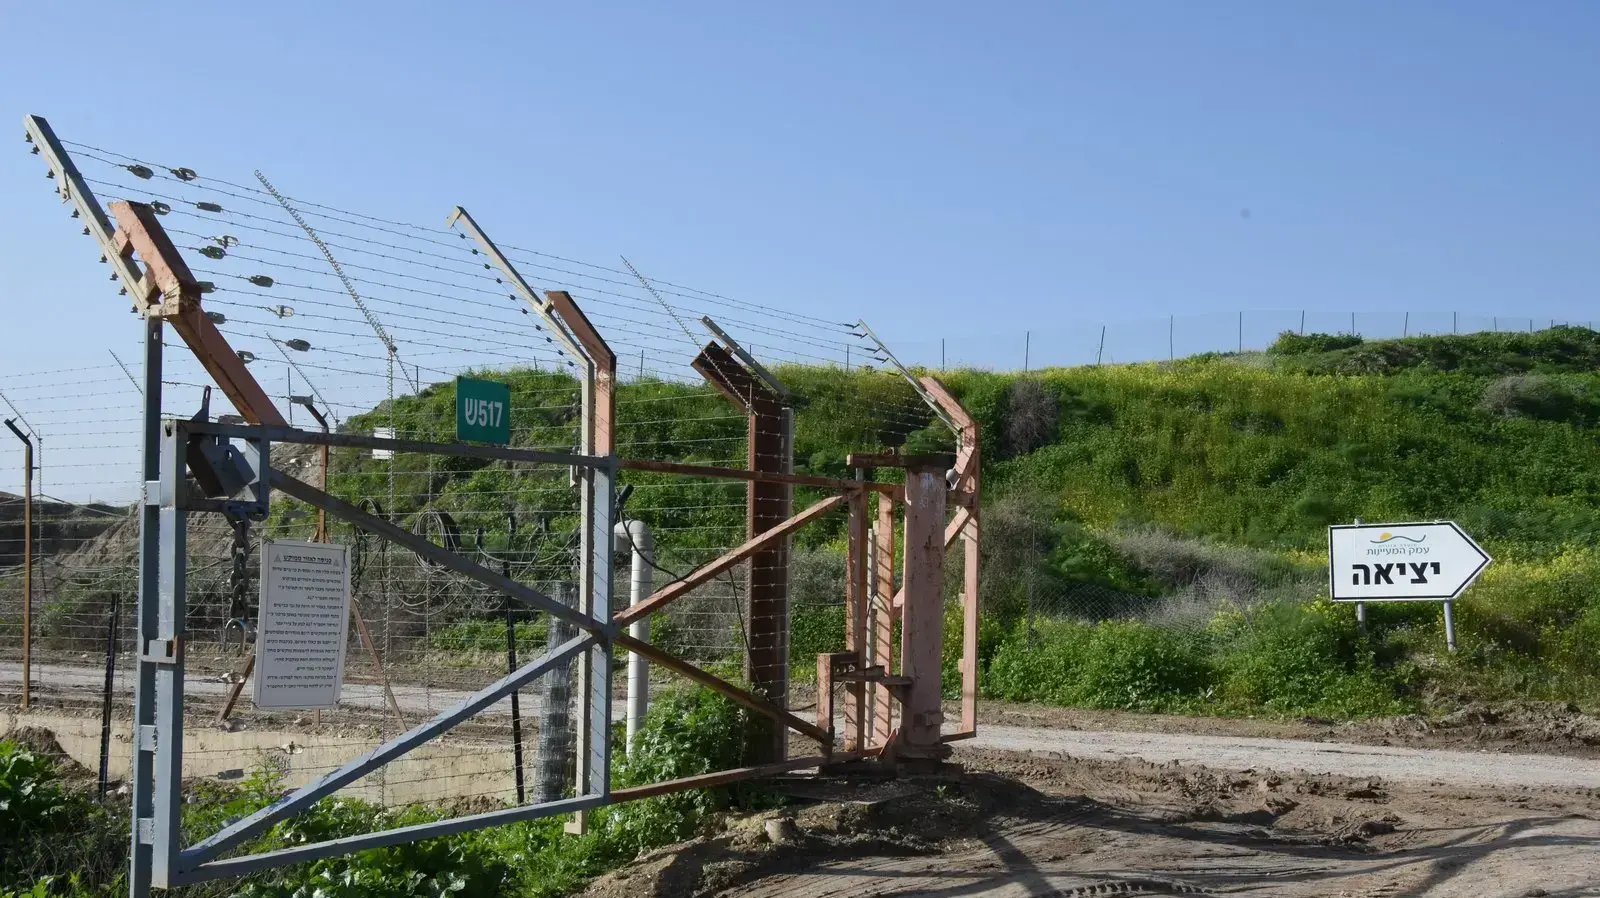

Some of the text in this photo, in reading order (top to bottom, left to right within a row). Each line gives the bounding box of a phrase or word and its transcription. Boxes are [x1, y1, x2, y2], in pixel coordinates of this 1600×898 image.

[1366, 547, 1430, 556] עמק המעיינות
[317, 556, 332, 564] כניסה
[1352, 561, 1441, 585] יציאה
